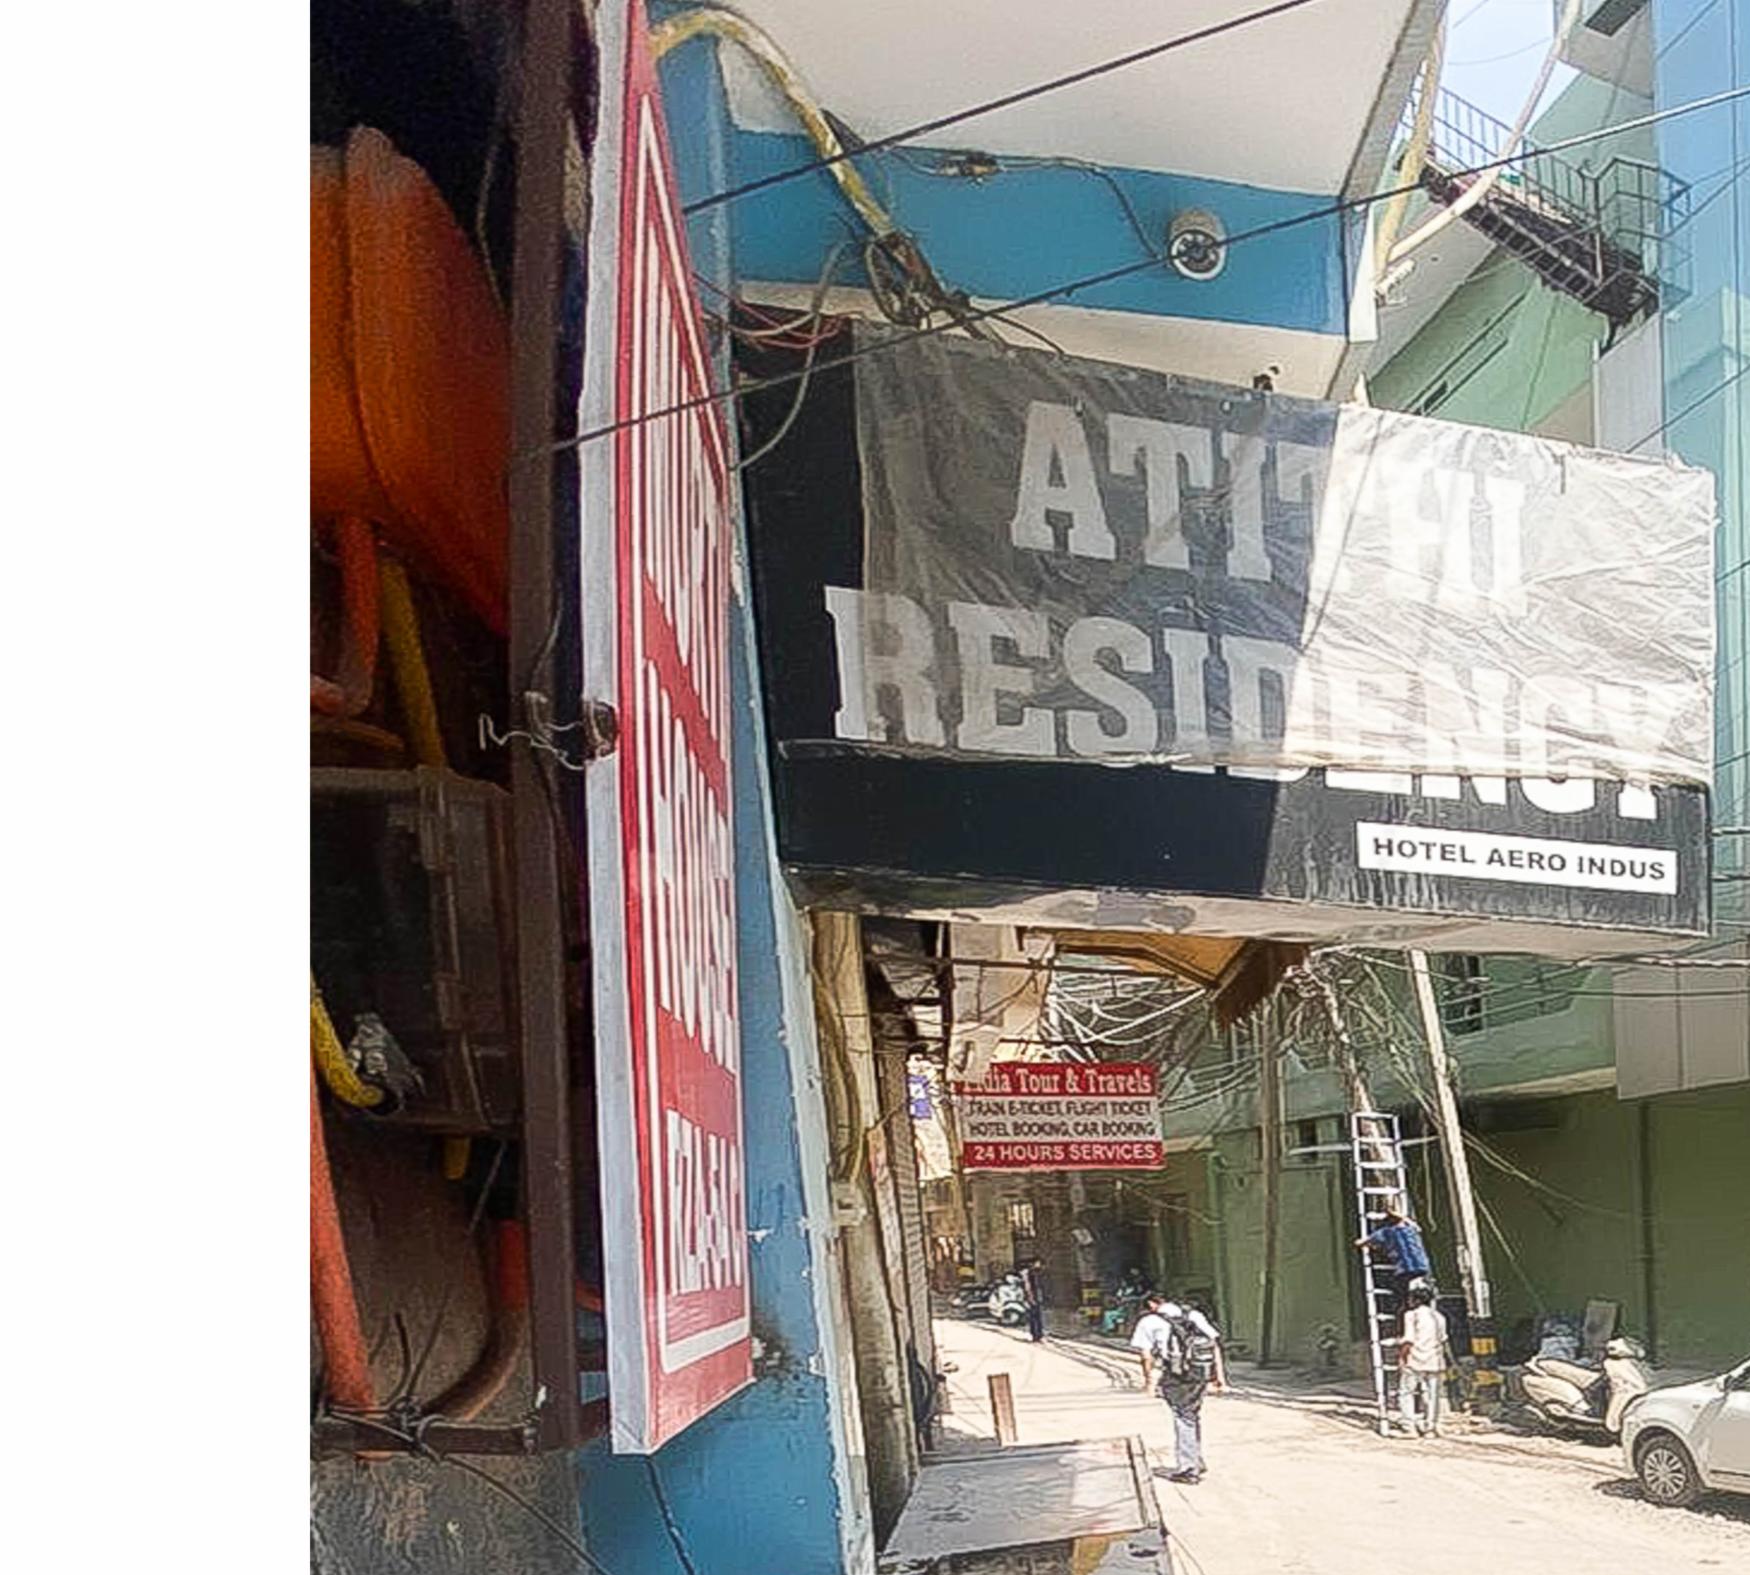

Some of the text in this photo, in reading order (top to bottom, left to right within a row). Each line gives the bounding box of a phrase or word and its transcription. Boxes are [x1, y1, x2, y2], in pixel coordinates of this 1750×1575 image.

[1010, 399, 1529, 618] ATITHI
[824, 586, 1692, 822] RESIDENCY
[646, 656, 736, 1075] HOUSE
[1373, 836, 1667, 881] HOTEL AERO INDUS
[1015, 1067, 1060, 1094] Tour
[1065, 1066, 1082, 1094] &
[1084, 1066, 1152, 1094] Travels
[967, 1100, 1006, 1117] TRAIN
[1065, 1100, 1107, 1116] FLIGHT
[1109, 1100, 1151, 1116] TICKET
[967, 1121, 1010, 1137] HOTEL
[1072, 1121, 1100, 1136] CAR
[1102, 1121, 1156, 1136] BOOKING
[973, 1143, 1158, 1161] 24 HOURS SERVICES
